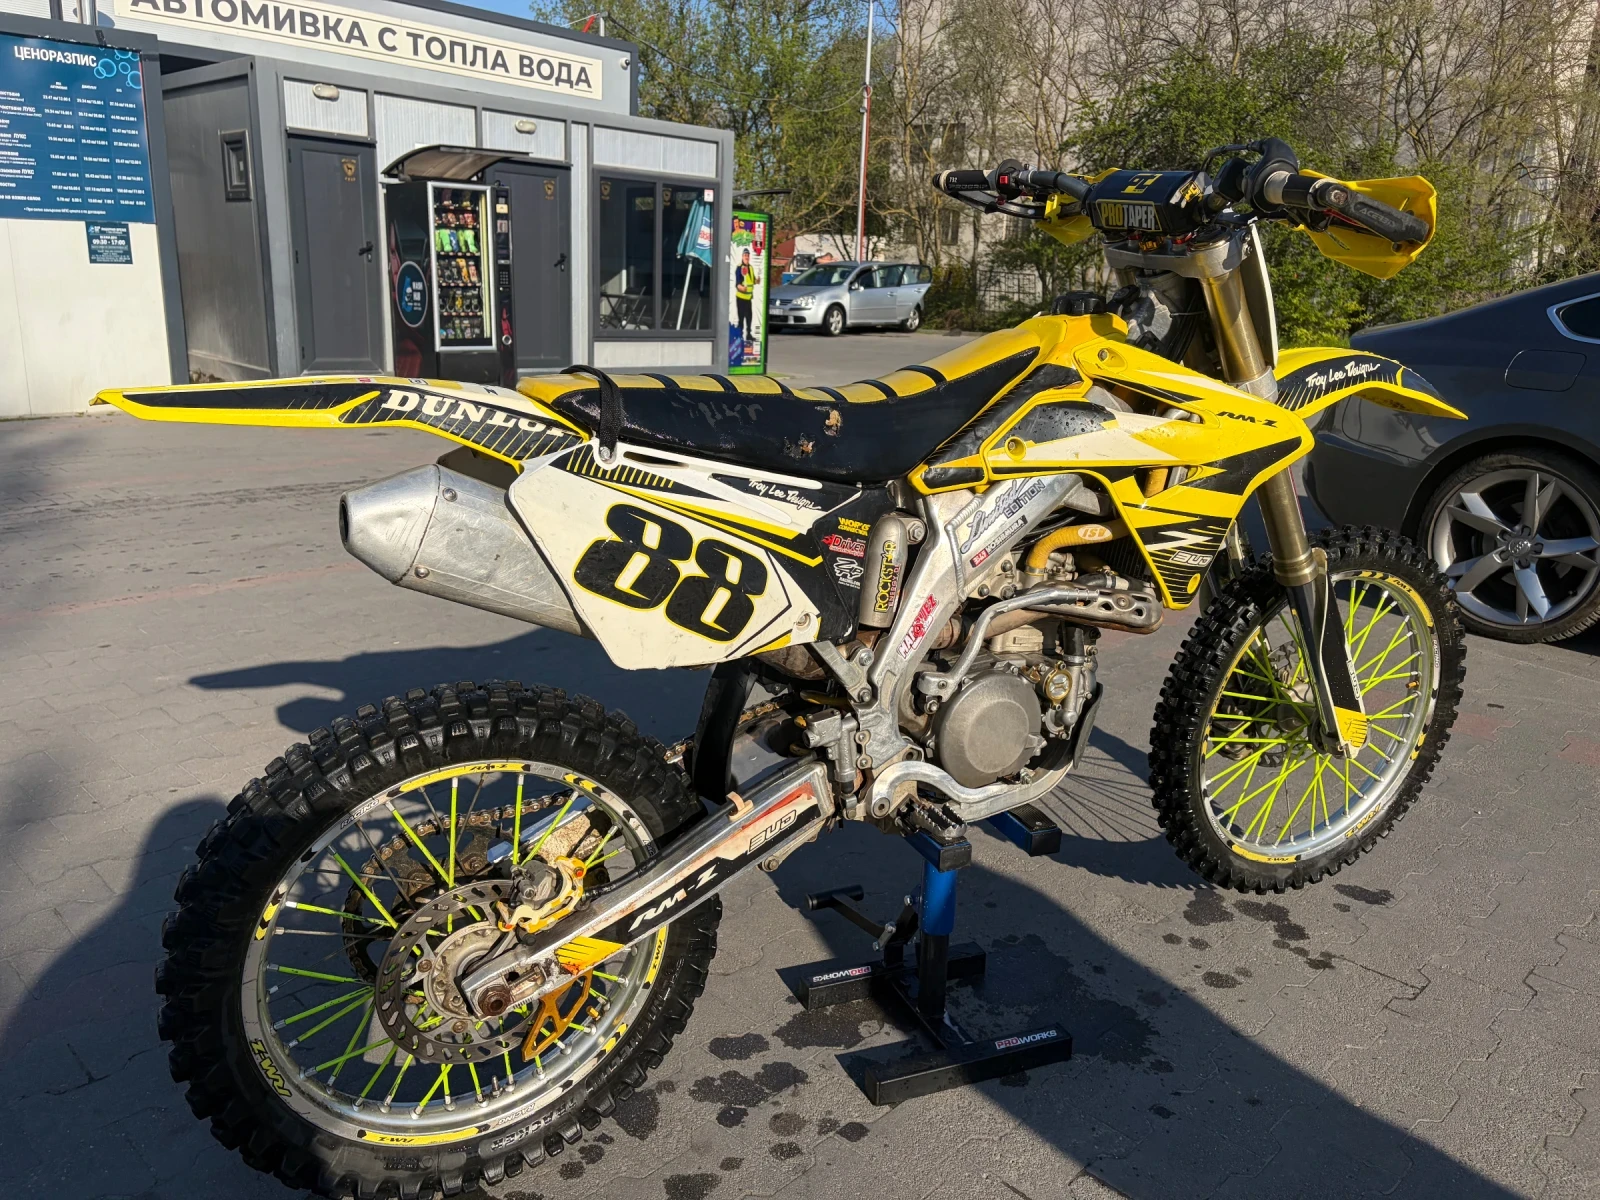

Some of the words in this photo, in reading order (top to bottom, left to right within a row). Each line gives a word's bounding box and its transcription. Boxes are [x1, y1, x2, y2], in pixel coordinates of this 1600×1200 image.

[129, 0, 368, 46] АВТОМИВКА
[378, 27, 399, 52] С
[406, 32, 511, 72] ТОПЛА
[518, 54, 593, 89] ВОДА
[14, 45, 97, 67] ЦЕНОРАЗПИС
[1306, 372, 1327, 391] Troy
[1328, 368, 1346, 383] Lee
[768, 484, 787, 498] Lee
[1003, 476, 1046, 519] EDITION
[572, 503, 769, 644] 88
[812, 965, 871, 983] PROWORKS
[995, 1029, 1057, 1050] PROWORKS
